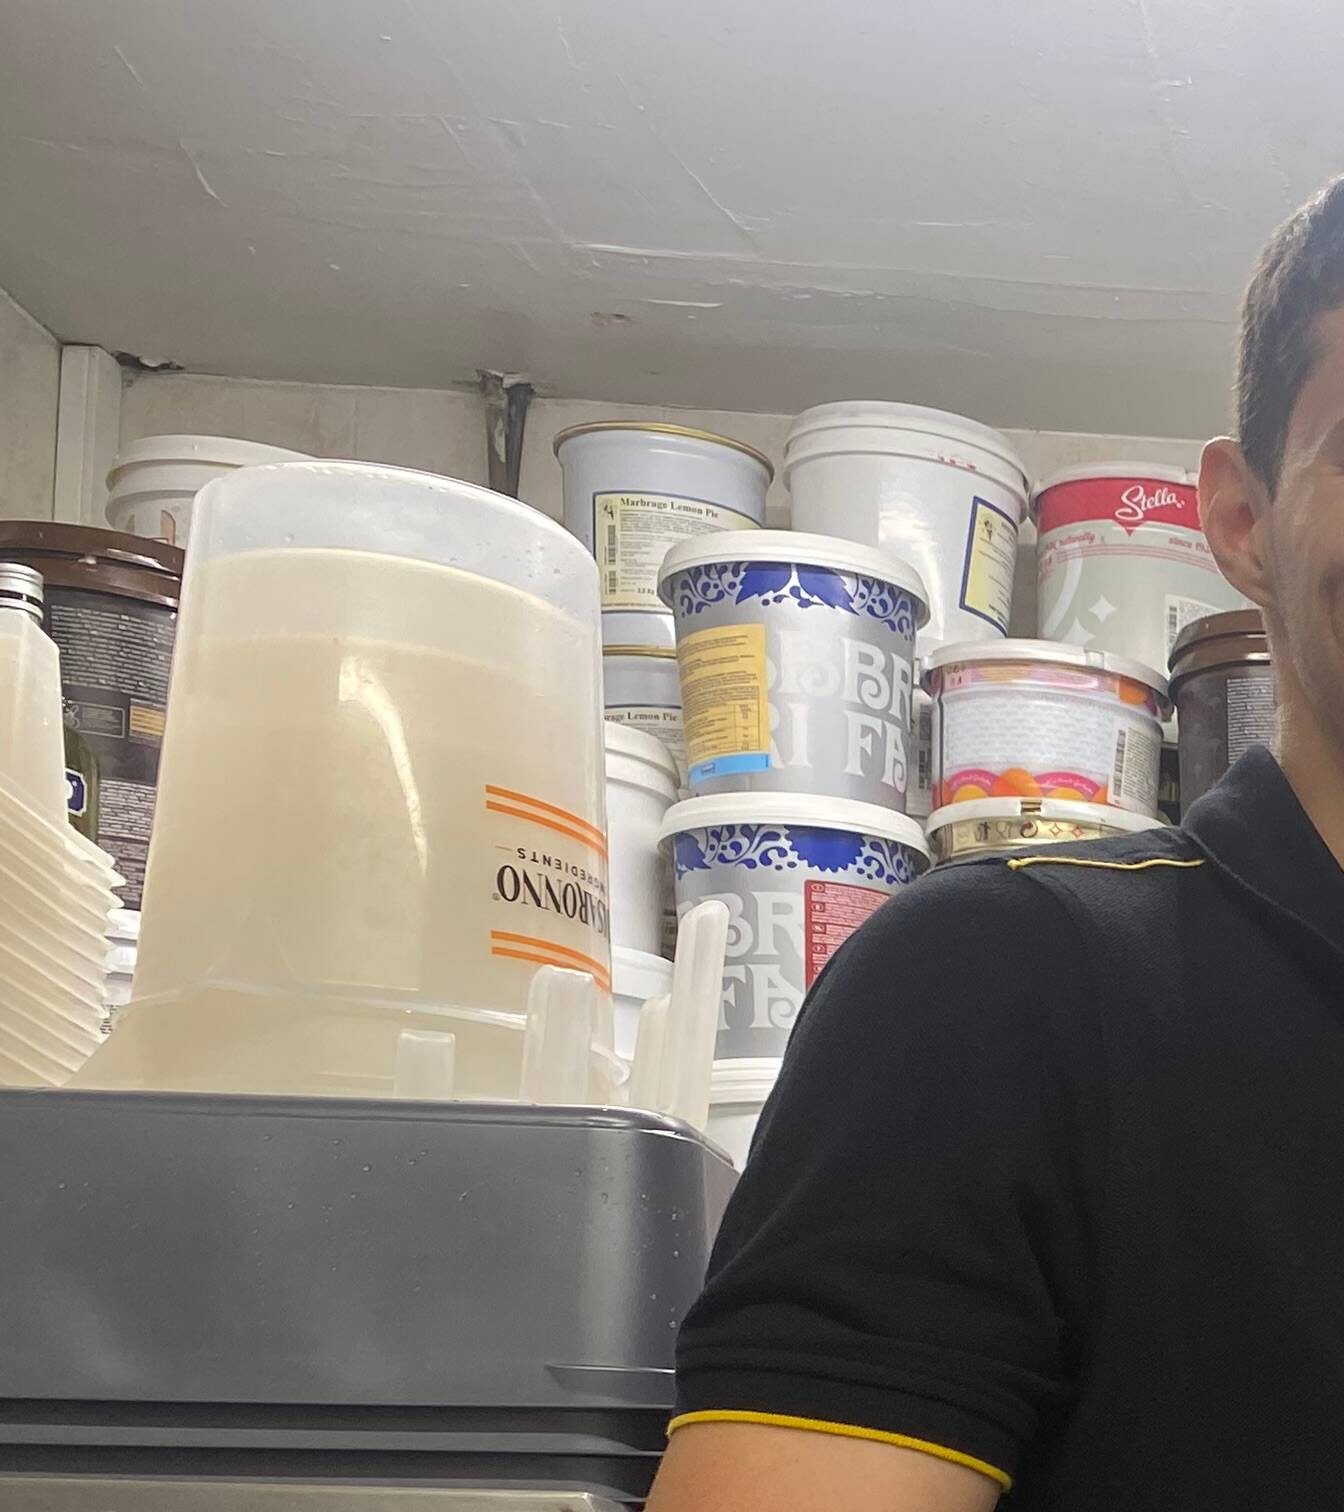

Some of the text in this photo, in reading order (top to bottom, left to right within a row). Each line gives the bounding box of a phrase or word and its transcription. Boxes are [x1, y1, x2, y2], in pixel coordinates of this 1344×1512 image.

[619, 496, 719, 519] Marbrage Lemon Pie
[1115, 484, 1180, 521] Stella
[627, 711, 660, 721] Lemon
[662, 712, 678, 722] Pie
[496, 864, 611, 946] ISARONNO
